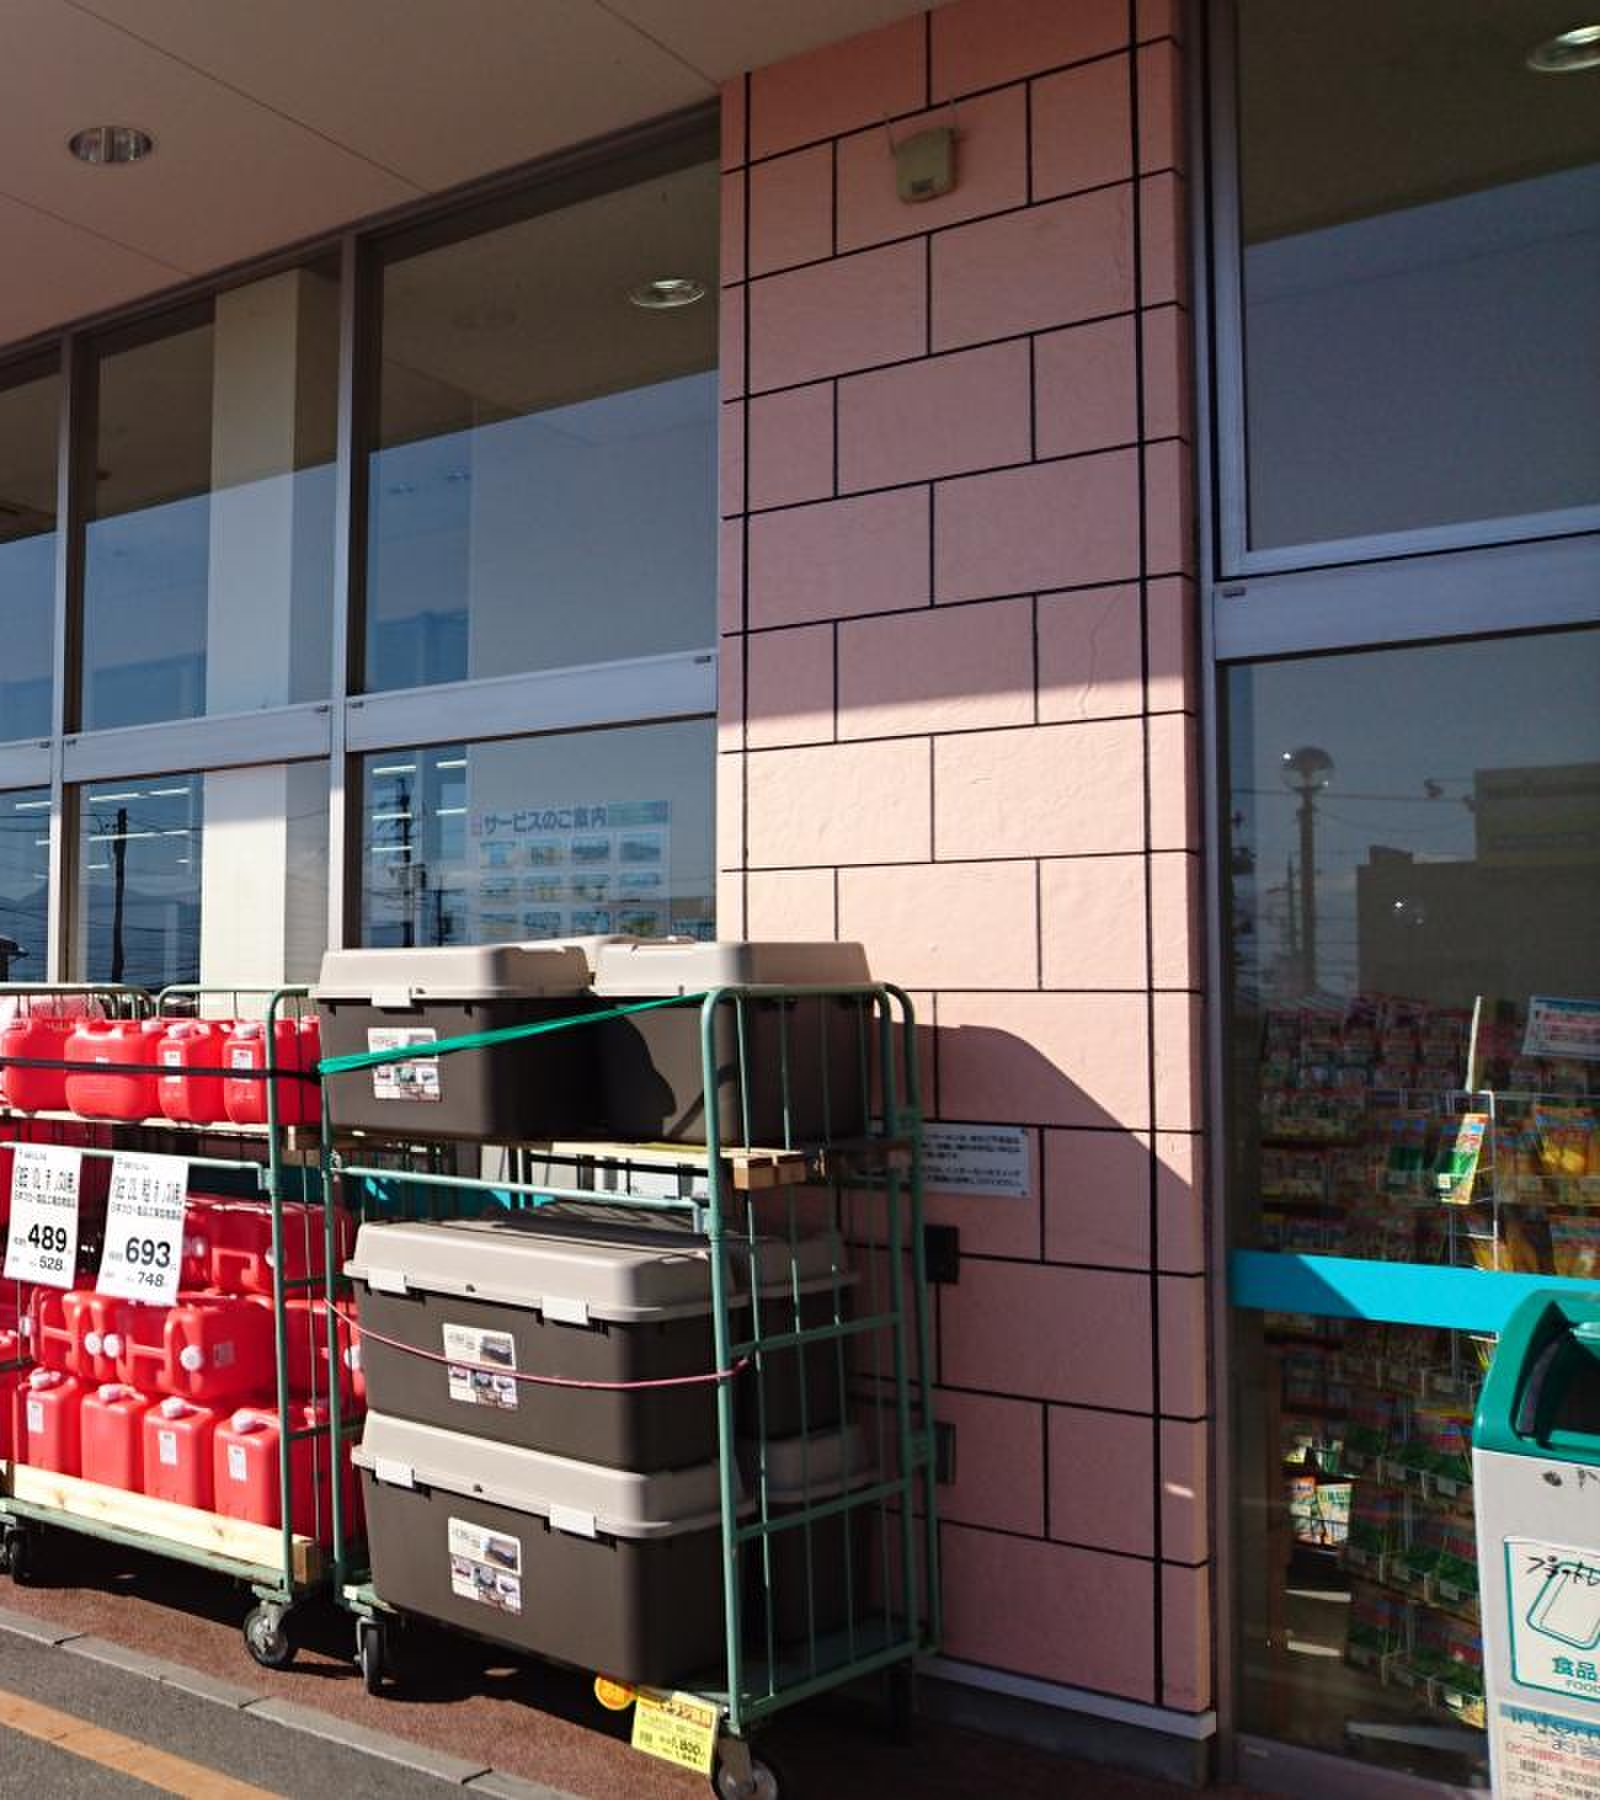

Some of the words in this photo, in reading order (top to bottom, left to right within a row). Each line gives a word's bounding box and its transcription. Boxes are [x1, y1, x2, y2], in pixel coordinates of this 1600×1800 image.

[483, 805, 608, 835] サービスのご案内
[28, 1222, 68, 1253] 489
[125, 1236, 172, 1269] 693
[39, 1254, 64, 1272] 528
[137, 1271, 165, 1288] 748
